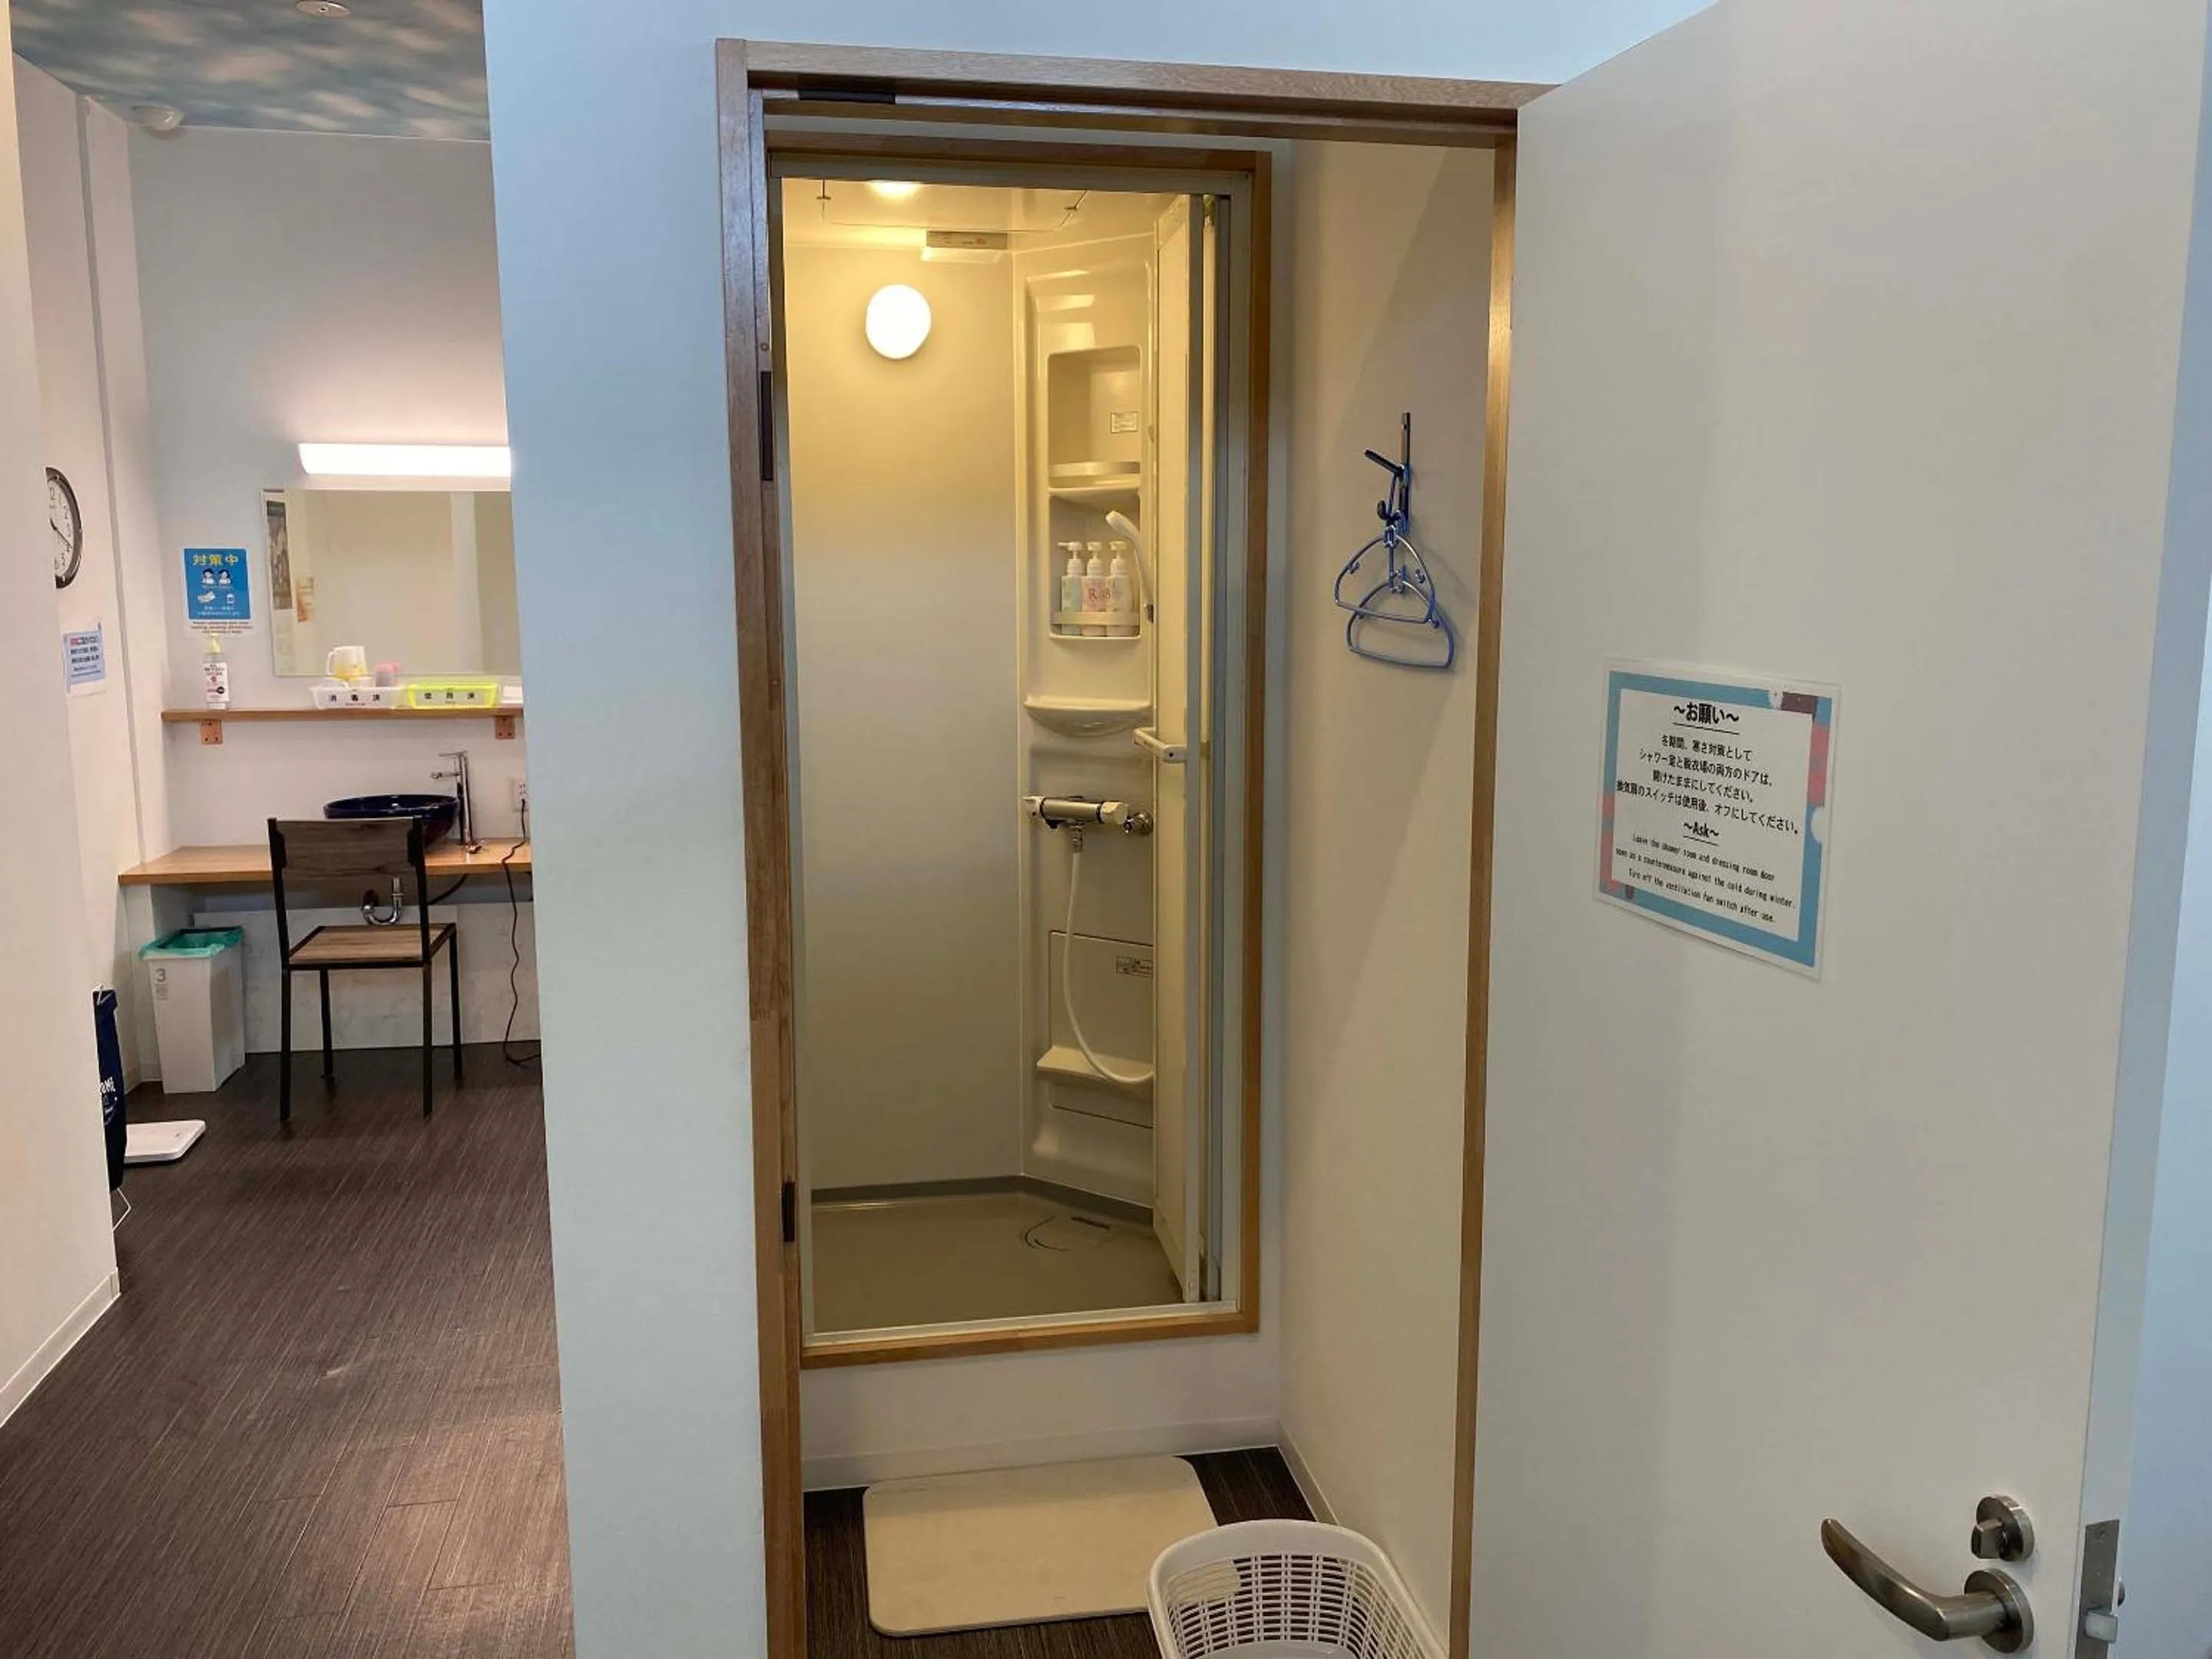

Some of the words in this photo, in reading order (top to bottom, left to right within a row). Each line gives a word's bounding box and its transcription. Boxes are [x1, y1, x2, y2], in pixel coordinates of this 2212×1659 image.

[1742, 866, 1758, 876] room
[1714, 876, 1725, 888] the
[1743, 886, 1767, 902] during
[1740, 905, 1760, 918] after
[155, 968, 167, 983] 3
